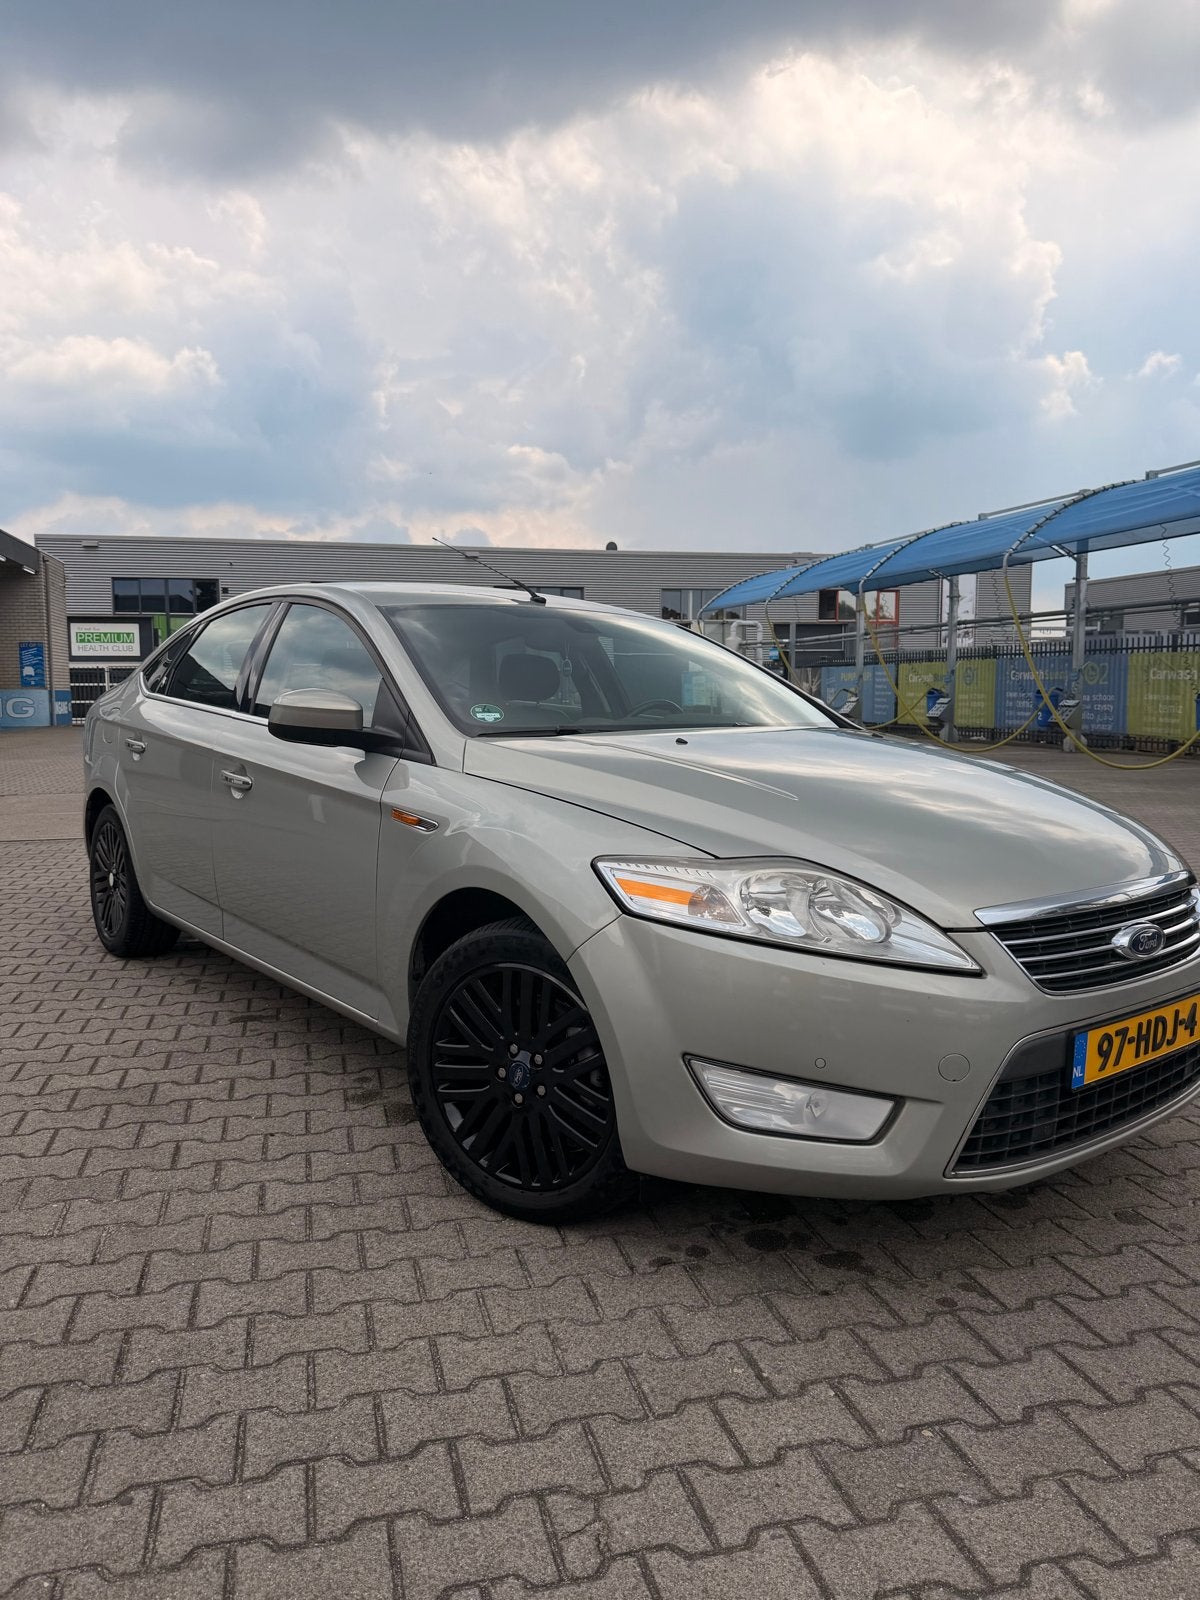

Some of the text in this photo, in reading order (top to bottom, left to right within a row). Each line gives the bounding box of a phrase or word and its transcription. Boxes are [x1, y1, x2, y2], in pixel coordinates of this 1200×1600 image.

[77, 633, 134, 643] PREMIUM
[1010, 670, 1044, 680] Carwah
[1037, 711, 1042, 720] 2
[1138, 932, 1158, 950] Ford
[1097, 1002, 1198, 1072] 97-HDJ-4
[1072, 1066, 1084, 1079] NL
